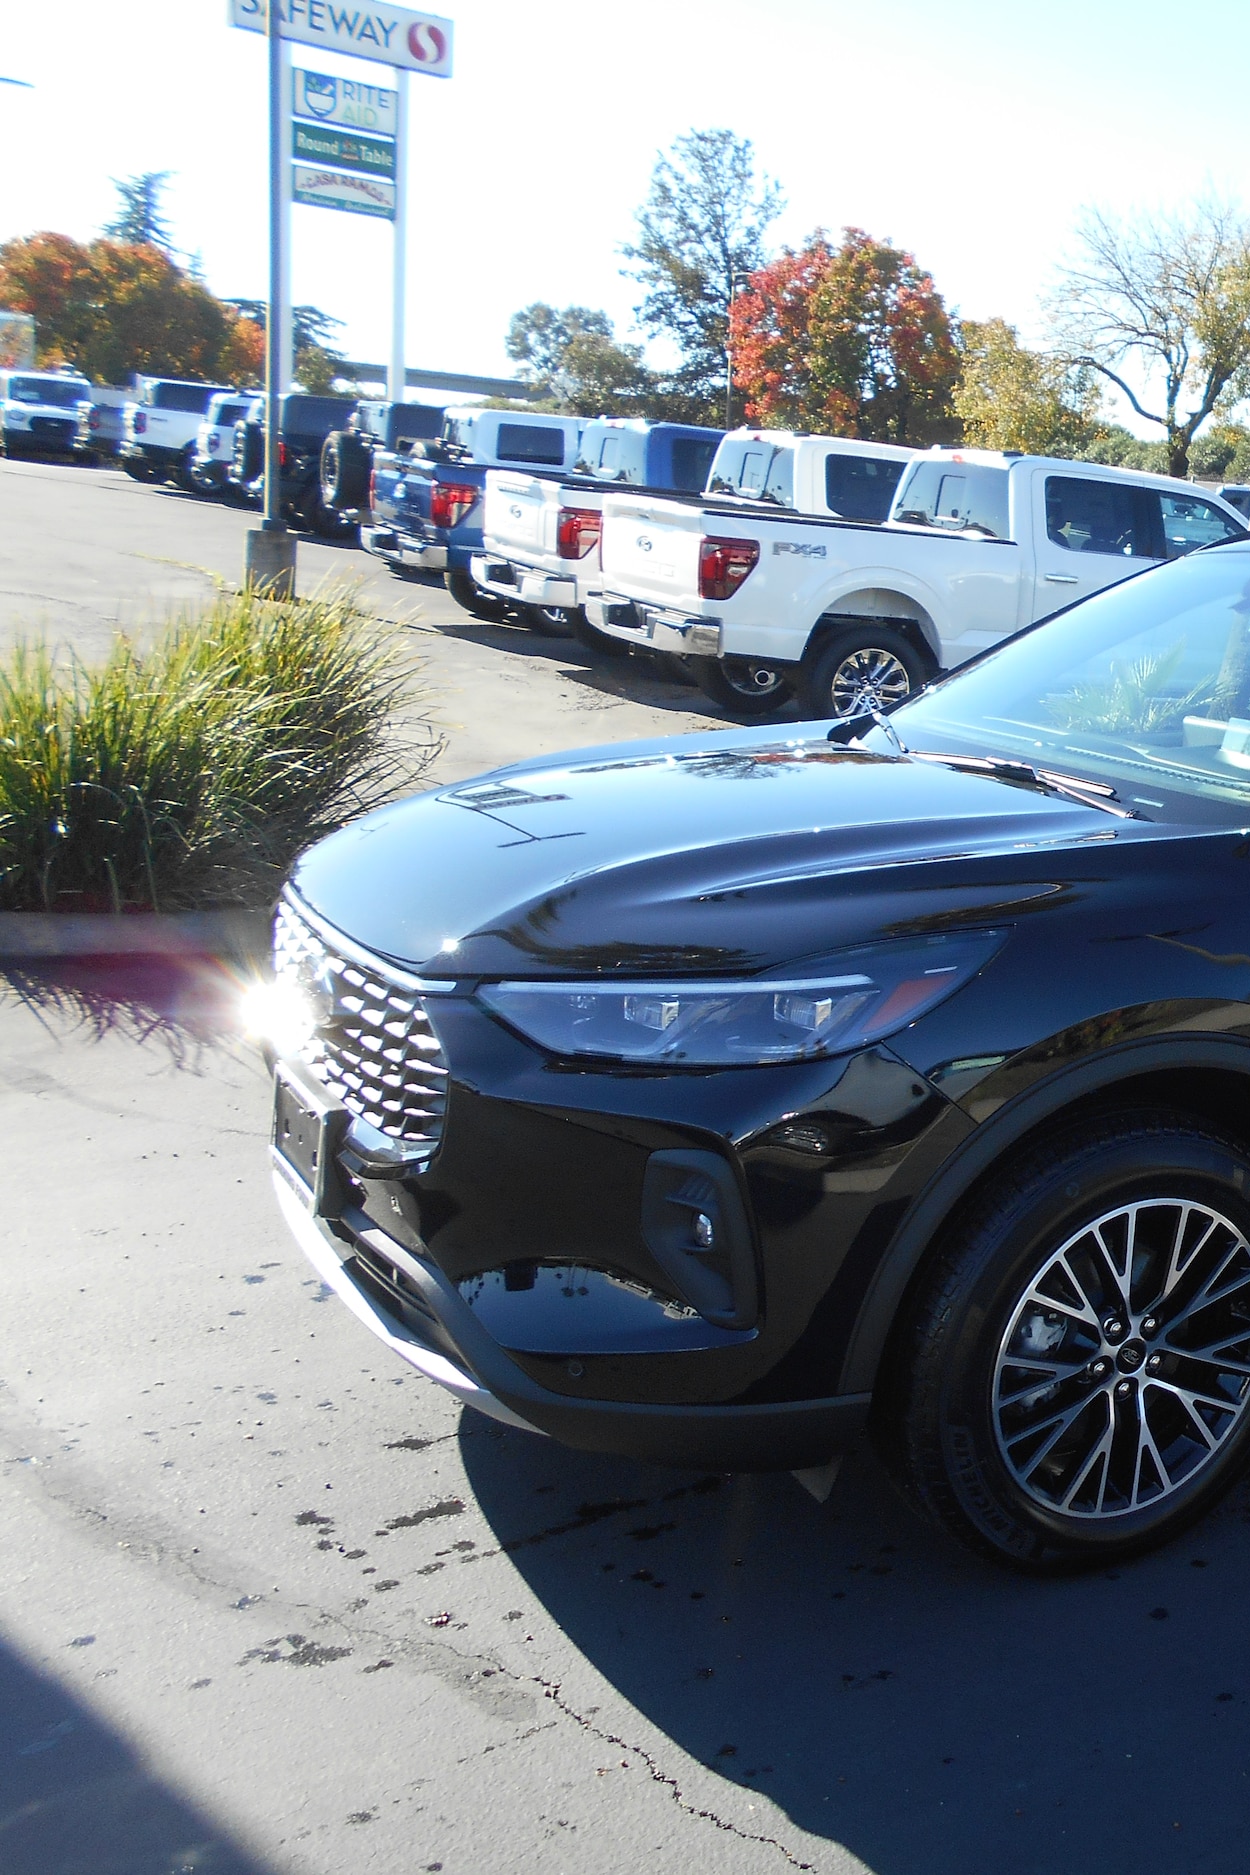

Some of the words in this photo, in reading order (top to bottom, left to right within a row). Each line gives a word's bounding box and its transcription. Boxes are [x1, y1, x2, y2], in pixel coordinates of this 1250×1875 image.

[342, 80, 390, 109] RITE
[342, 103, 378, 126] AID
[296, 131, 339, 155] Round
[359, 144, 393, 167] Table
[772, 541, 827, 557] FX4
